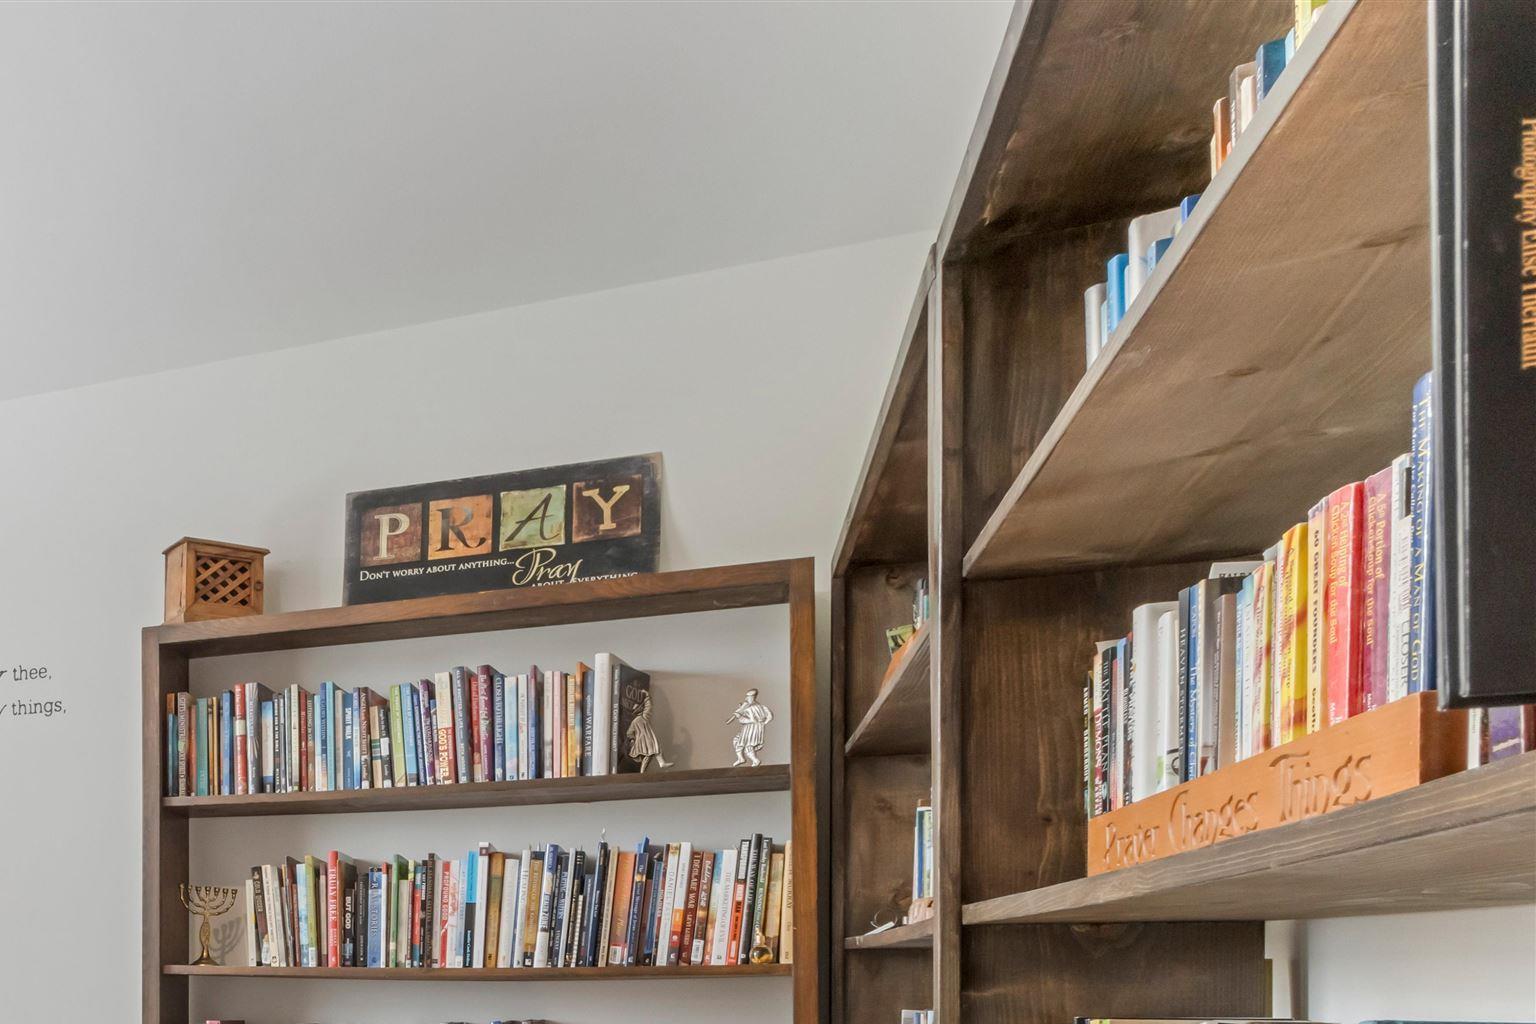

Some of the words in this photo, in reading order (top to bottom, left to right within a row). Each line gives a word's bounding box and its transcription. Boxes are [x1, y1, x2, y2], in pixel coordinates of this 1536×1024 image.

[1416, 437, 1429, 513] MAKING
[373, 484, 631, 561] PRAY
[1375, 520, 1387, 564] Portion
[359, 569, 391, 582] DON'T
[392, 566, 424, 578] WORRY
[425, 563, 456, 575] ABOUT
[511, 547, 584, 586] Pray
[1413, 562, 1425, 608] MAN
[12, 665, 53, 682] thee,
[1411, 639, 1422, 681] GOD
[11, 698, 66, 717] things,
[584, 716, 593, 757] WARFARE
[1268, 750, 1374, 823] Things
